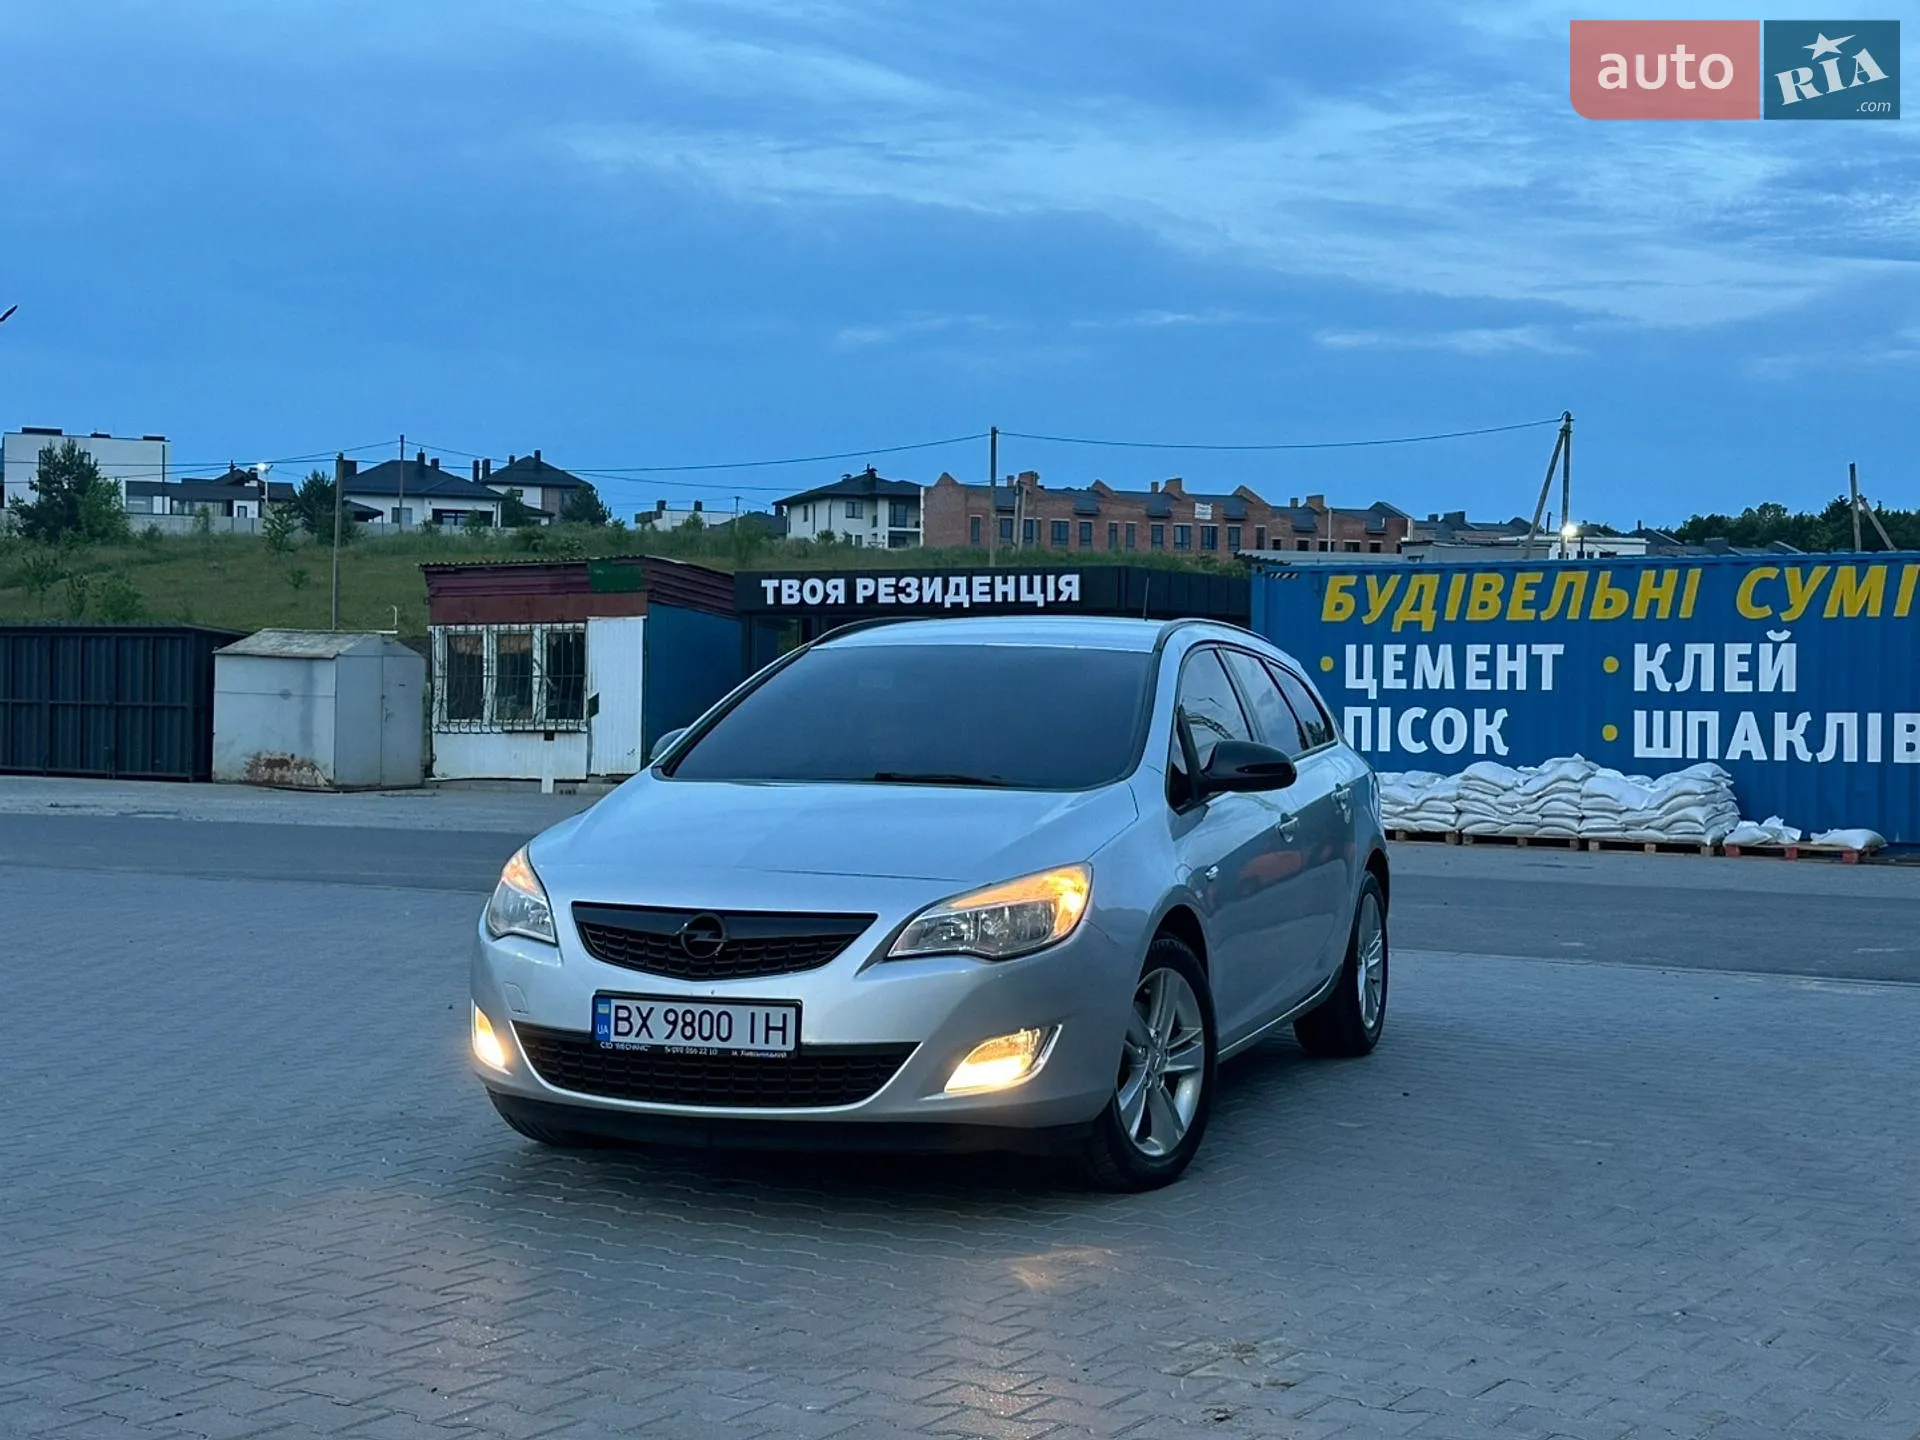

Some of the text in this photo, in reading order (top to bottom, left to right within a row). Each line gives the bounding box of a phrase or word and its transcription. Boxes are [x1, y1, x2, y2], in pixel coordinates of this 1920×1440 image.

[761, 574, 1080, 608] ТВОЯ РЕЗИДЕНЦІЯ
[1321, 564, 1920, 632] БУДІВЕЛЬНІ СУМІ
[1344, 643, 1565, 700] ЦЕМЕНТ
[1633, 629, 1797, 693] КЛЕЙ
[1343, 706, 1510, 756] ПІСОК
[1633, 710, 1920, 764] ШПАКЛІВ
[597, 1023, 609, 1035] UA
[613, 1004, 787, 1046] BX 9800 IH
